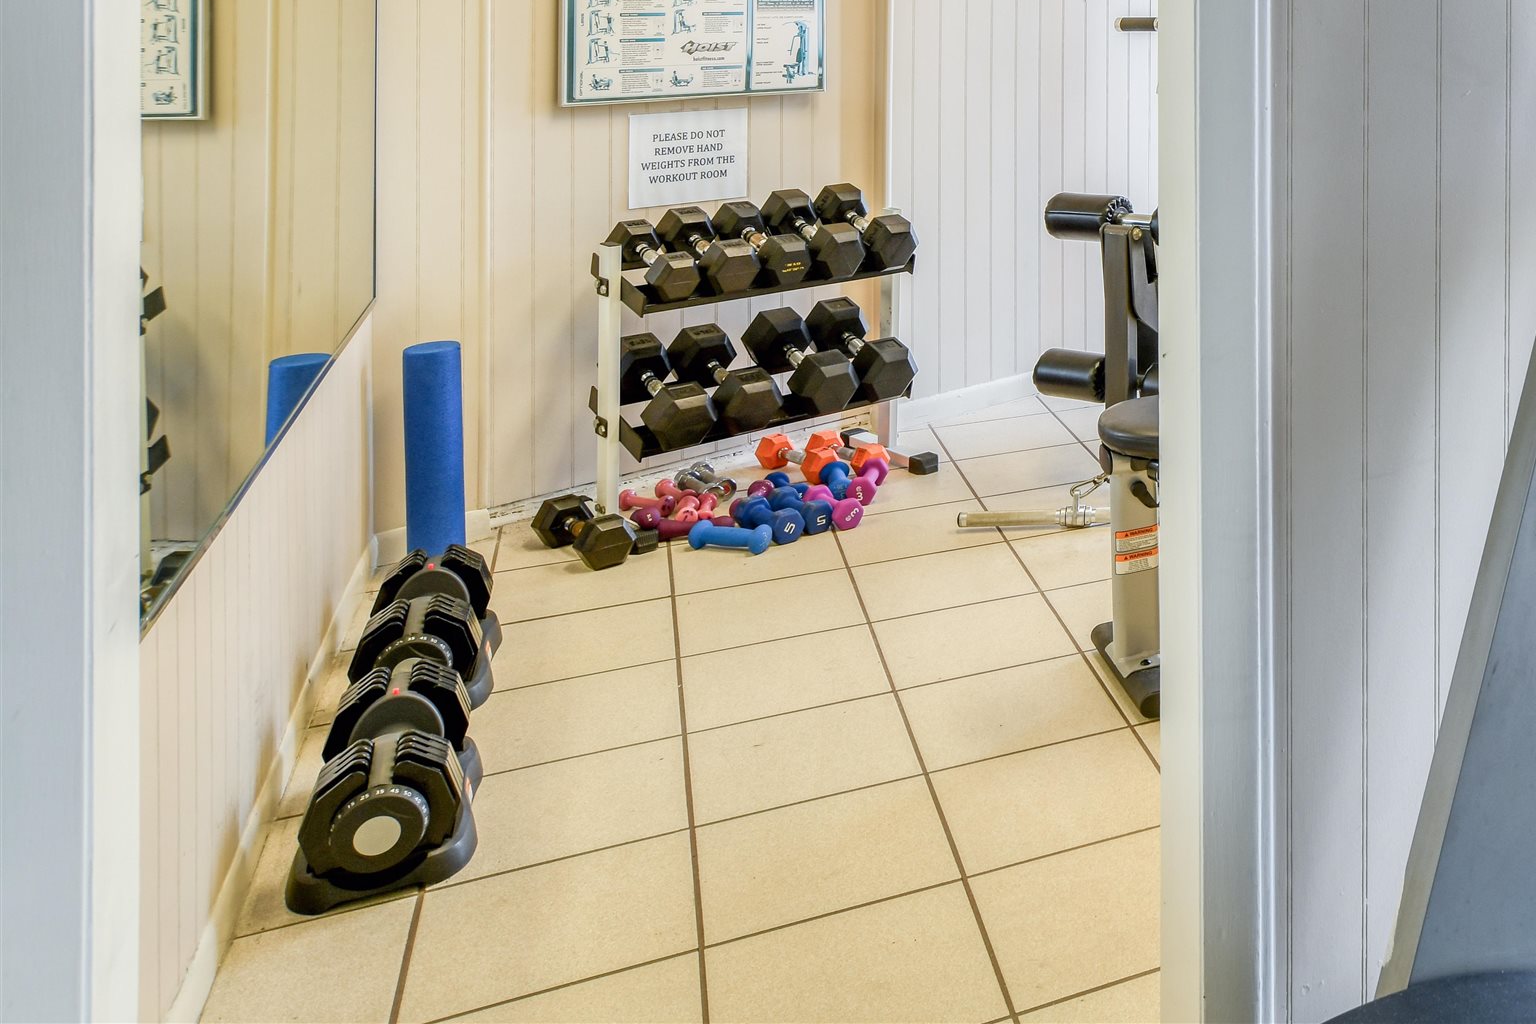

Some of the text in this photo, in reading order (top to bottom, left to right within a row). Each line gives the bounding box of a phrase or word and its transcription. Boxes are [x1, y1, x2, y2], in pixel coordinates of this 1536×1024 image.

[680, 40, 737, 55] HOIST
[652, 129, 726, 142] PLEASE DO NOT
[654, 142, 723, 156] REMOVE HAND
[641, 155, 735, 171] WEIGHTS FROM THE
[648, 169, 728, 184] WORKOUT ROOM
